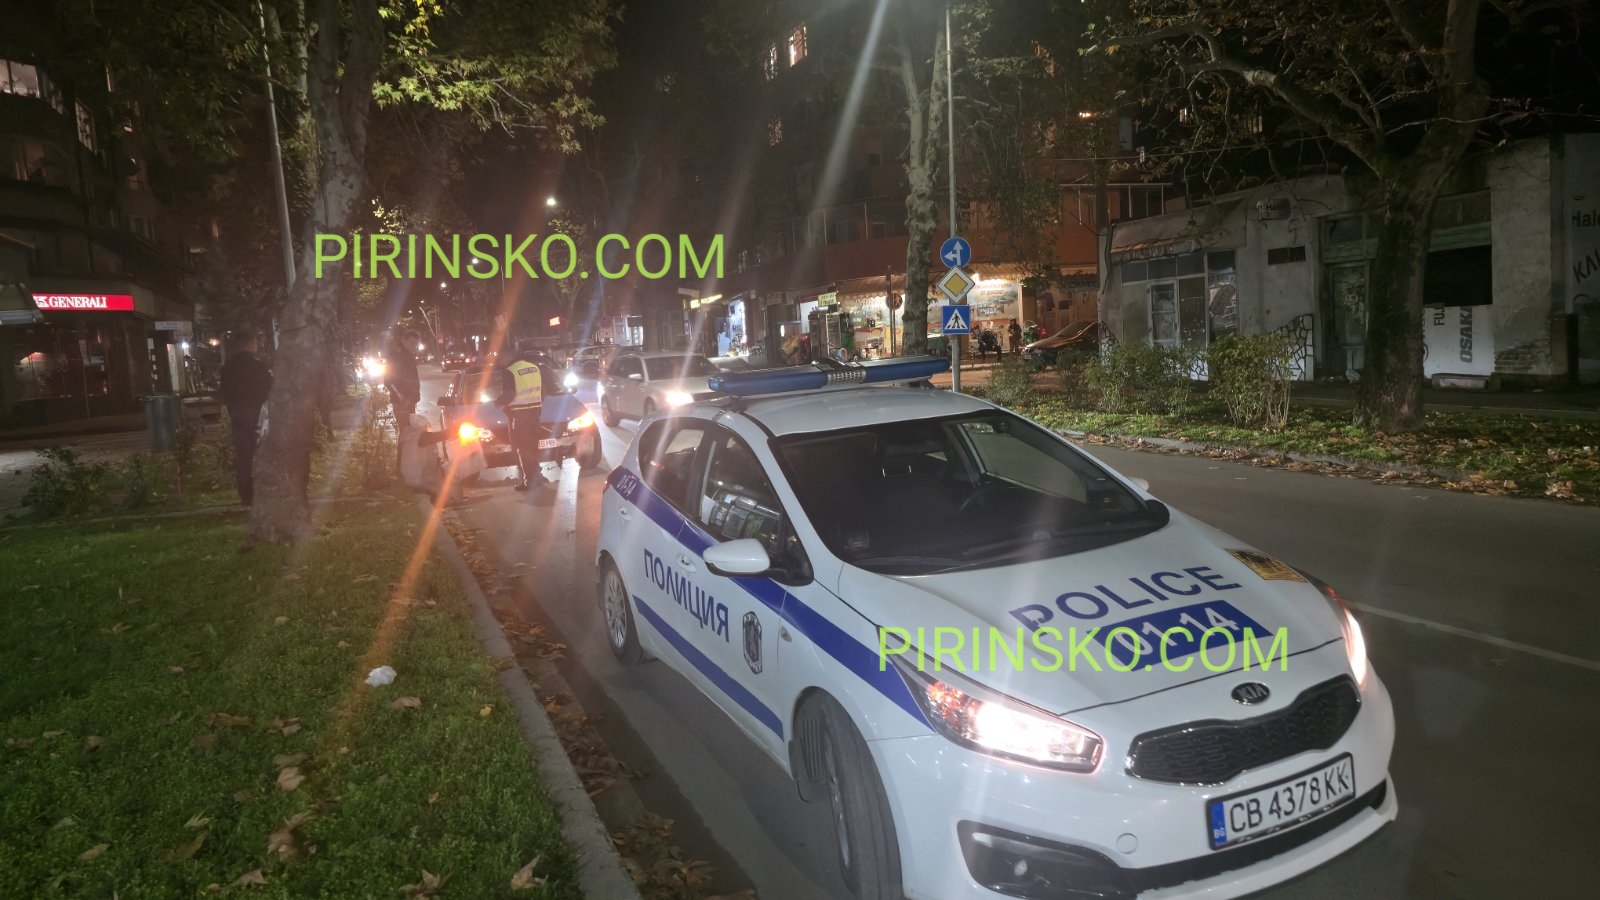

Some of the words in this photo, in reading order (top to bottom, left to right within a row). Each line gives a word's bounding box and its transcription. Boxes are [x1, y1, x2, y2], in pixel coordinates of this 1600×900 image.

[48, 295, 107, 308] GENERALI
[643, 548, 730, 643] ПОЛИЦИЯ
[1009, 566, 1243, 638] POLICE
[1234, 682, 1268, 702] KIA
[1230, 797, 1263, 833] CB
[1268, 777, 1322, 820] 4378
[1213, 827, 1226, 838] BG
